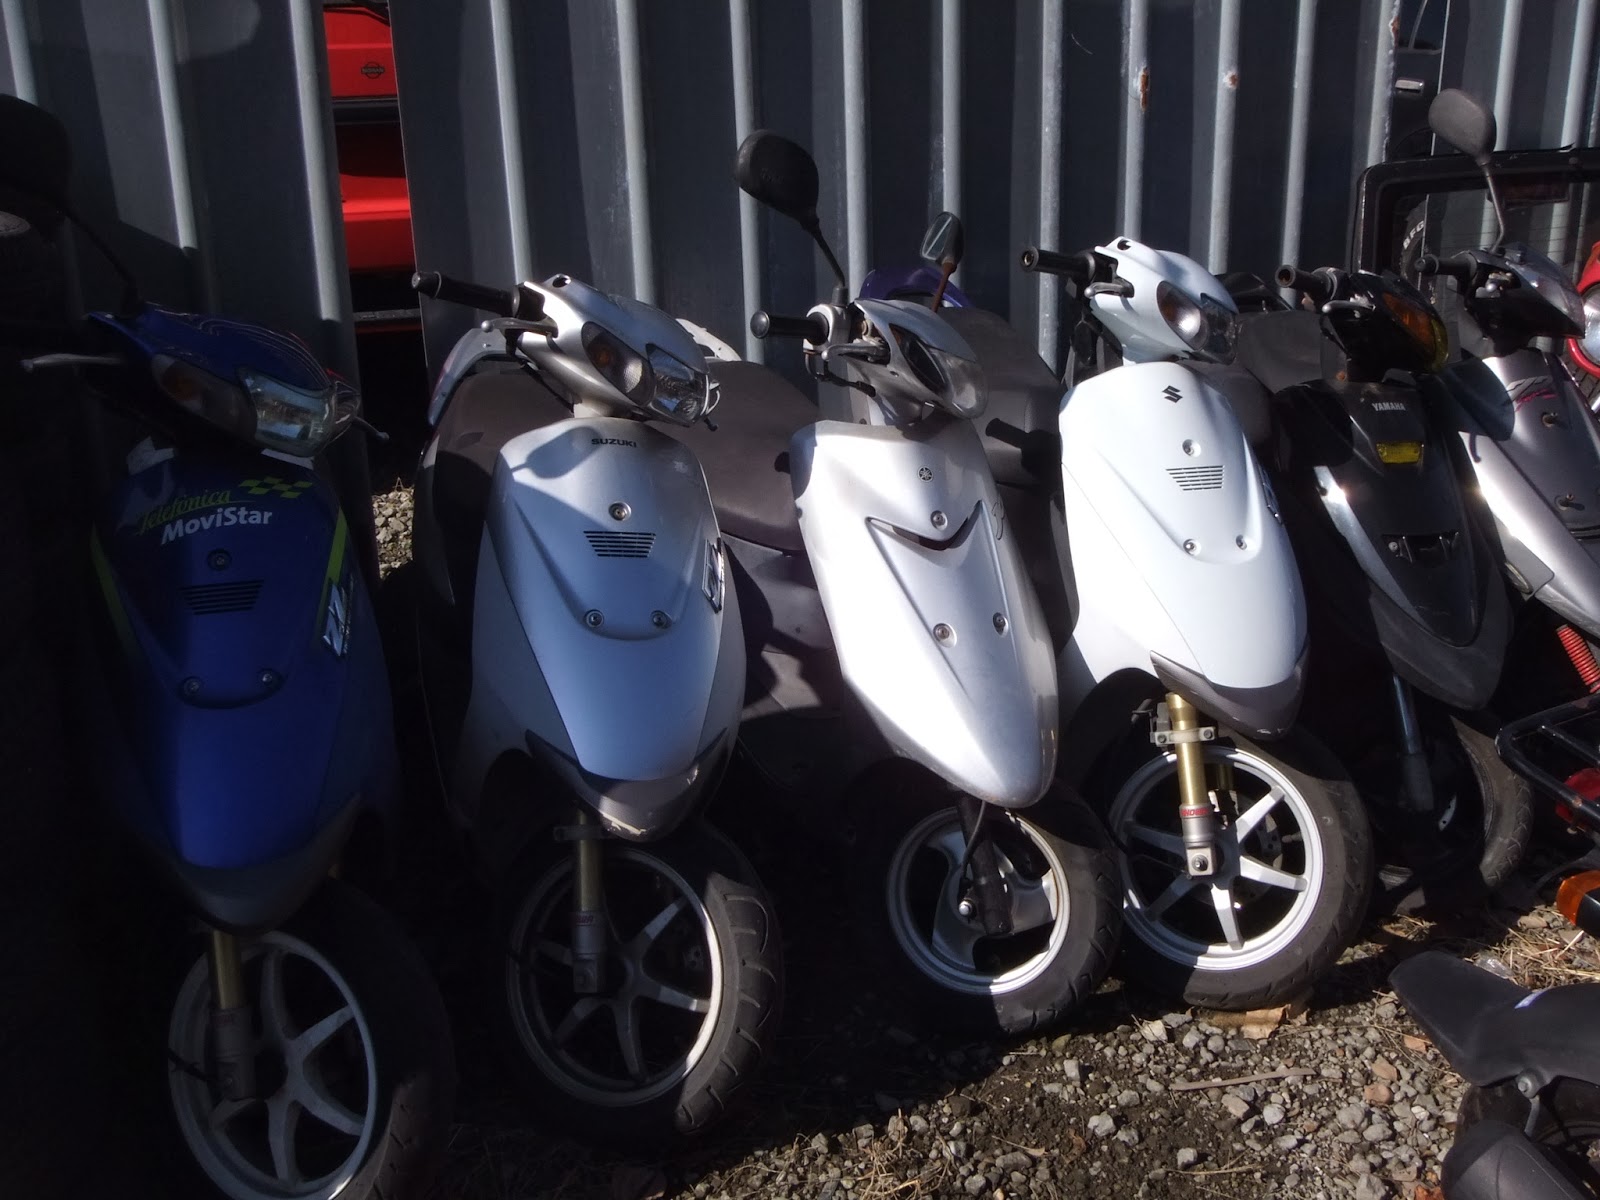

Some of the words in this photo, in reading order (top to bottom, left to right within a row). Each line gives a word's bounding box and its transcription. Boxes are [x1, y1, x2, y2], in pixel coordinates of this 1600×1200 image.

[1371, 401, 1406, 411] YAMAHA
[591, 438, 637, 448] SUZUKI
[161, 506, 273, 546] MoviStar
